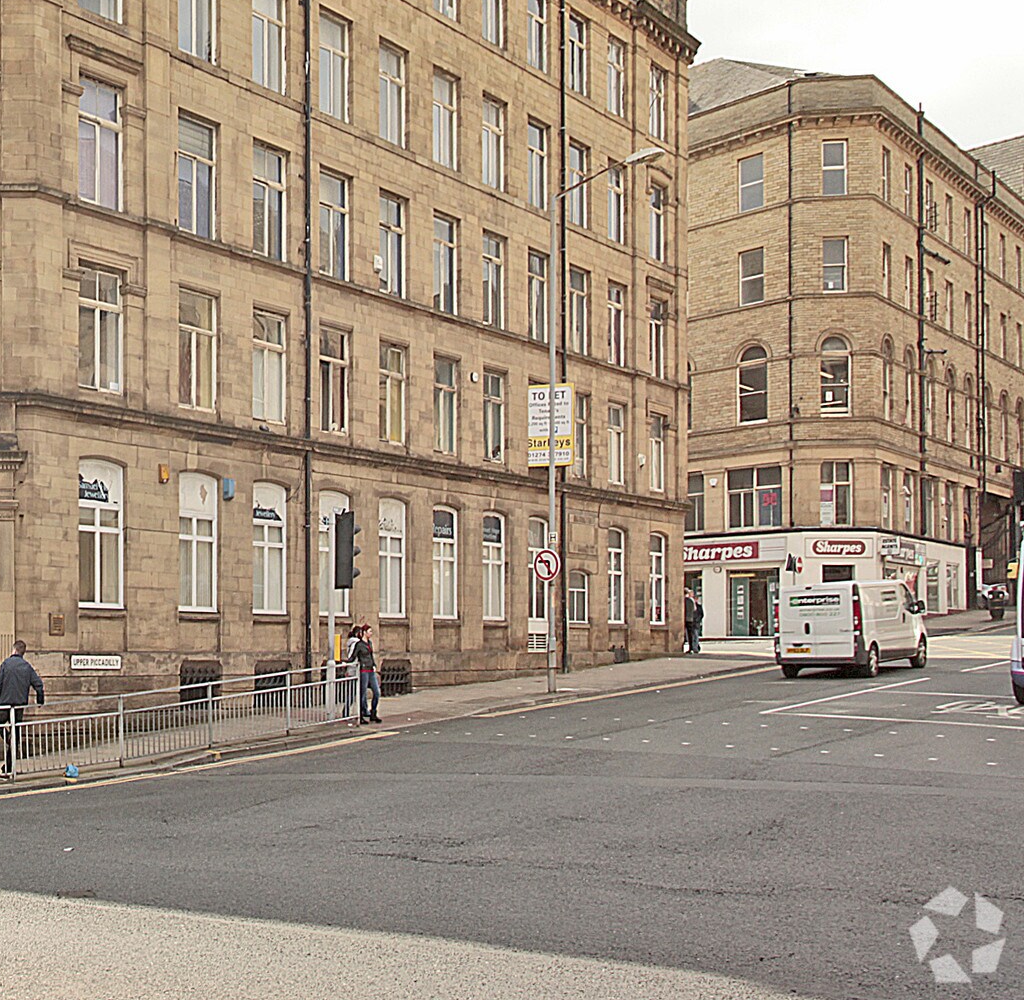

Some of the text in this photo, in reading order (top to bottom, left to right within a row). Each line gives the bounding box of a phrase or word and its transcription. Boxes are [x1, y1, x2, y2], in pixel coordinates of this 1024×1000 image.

[532, 391, 545, 401] TO
[815, 540, 862, 556] Sharpes
[791, 595, 840, 606] enterprise
[73, 658, 120, 667] UPPER PICCADILLY
